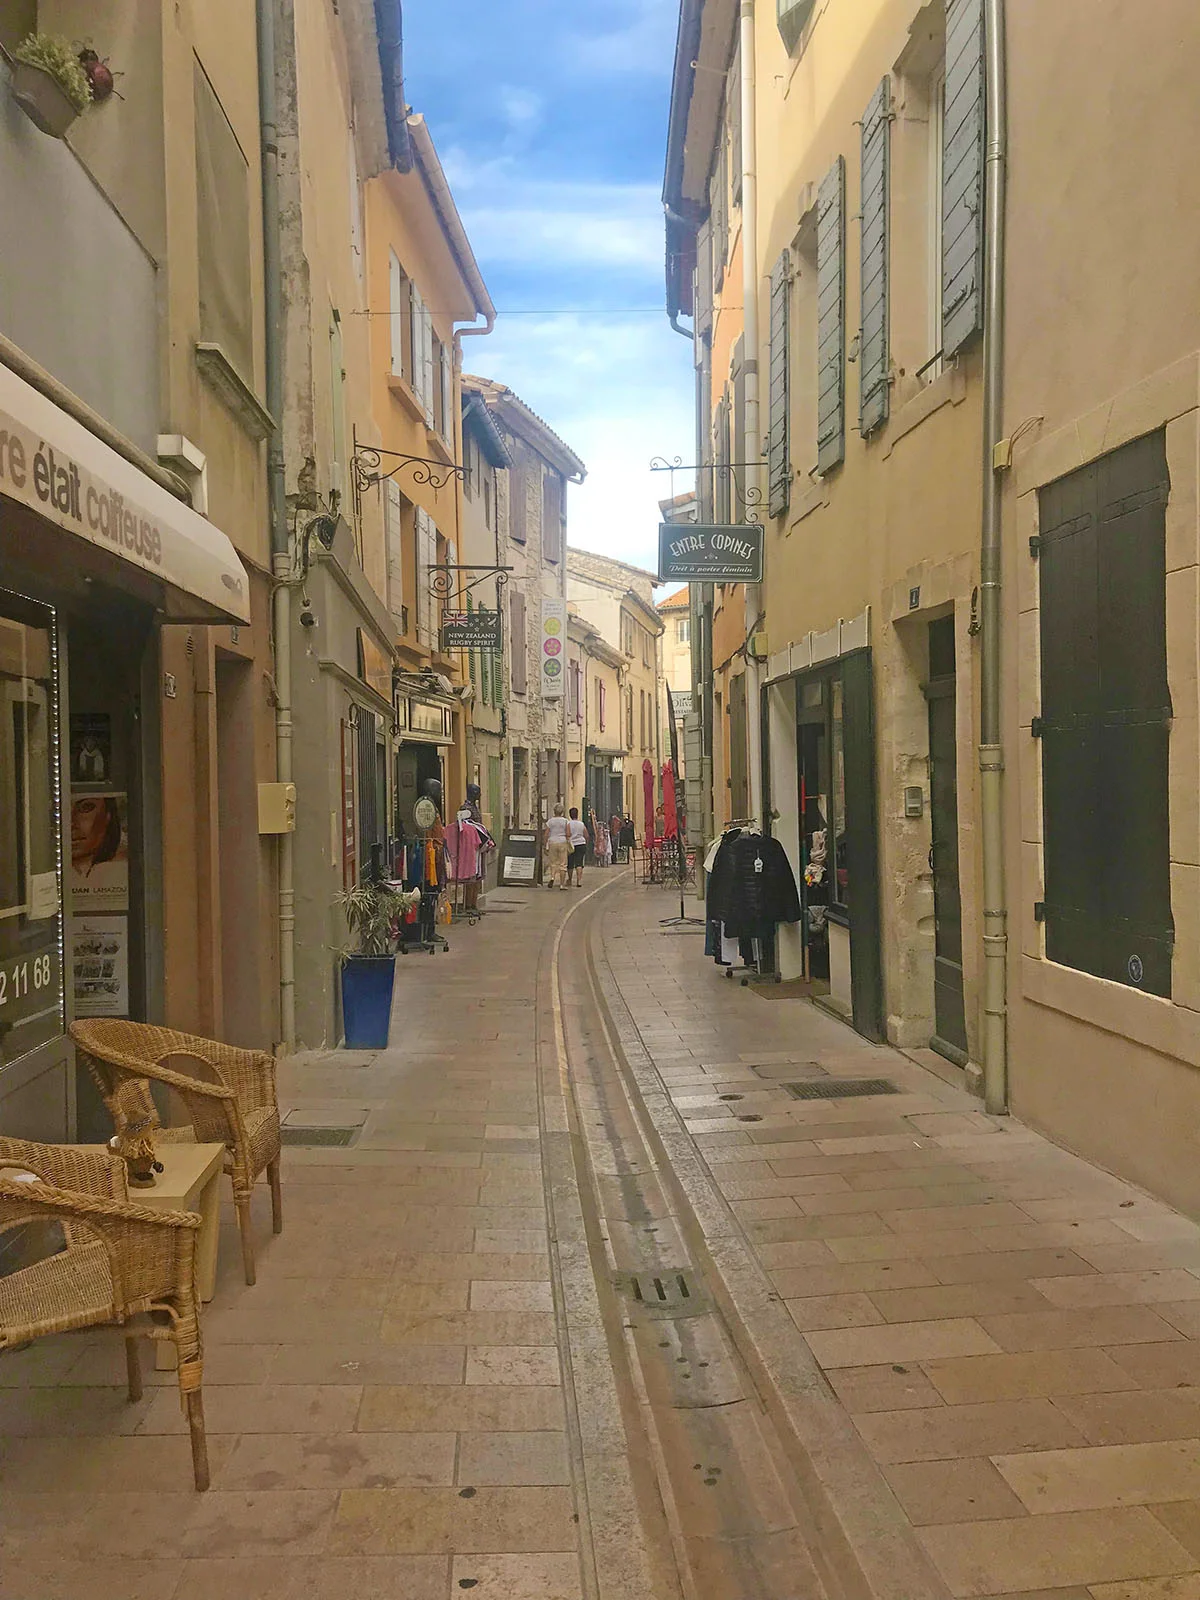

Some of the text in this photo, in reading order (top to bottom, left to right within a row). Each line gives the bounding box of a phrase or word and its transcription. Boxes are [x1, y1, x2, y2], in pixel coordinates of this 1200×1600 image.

[33, 441, 82, 522] était
[86, 486, 162, 565] coiffeuse
[669, 534, 755, 559] ENTRE COPINES
[12, 962, 28, 998] 11
[34, 954, 50, 990] 68
